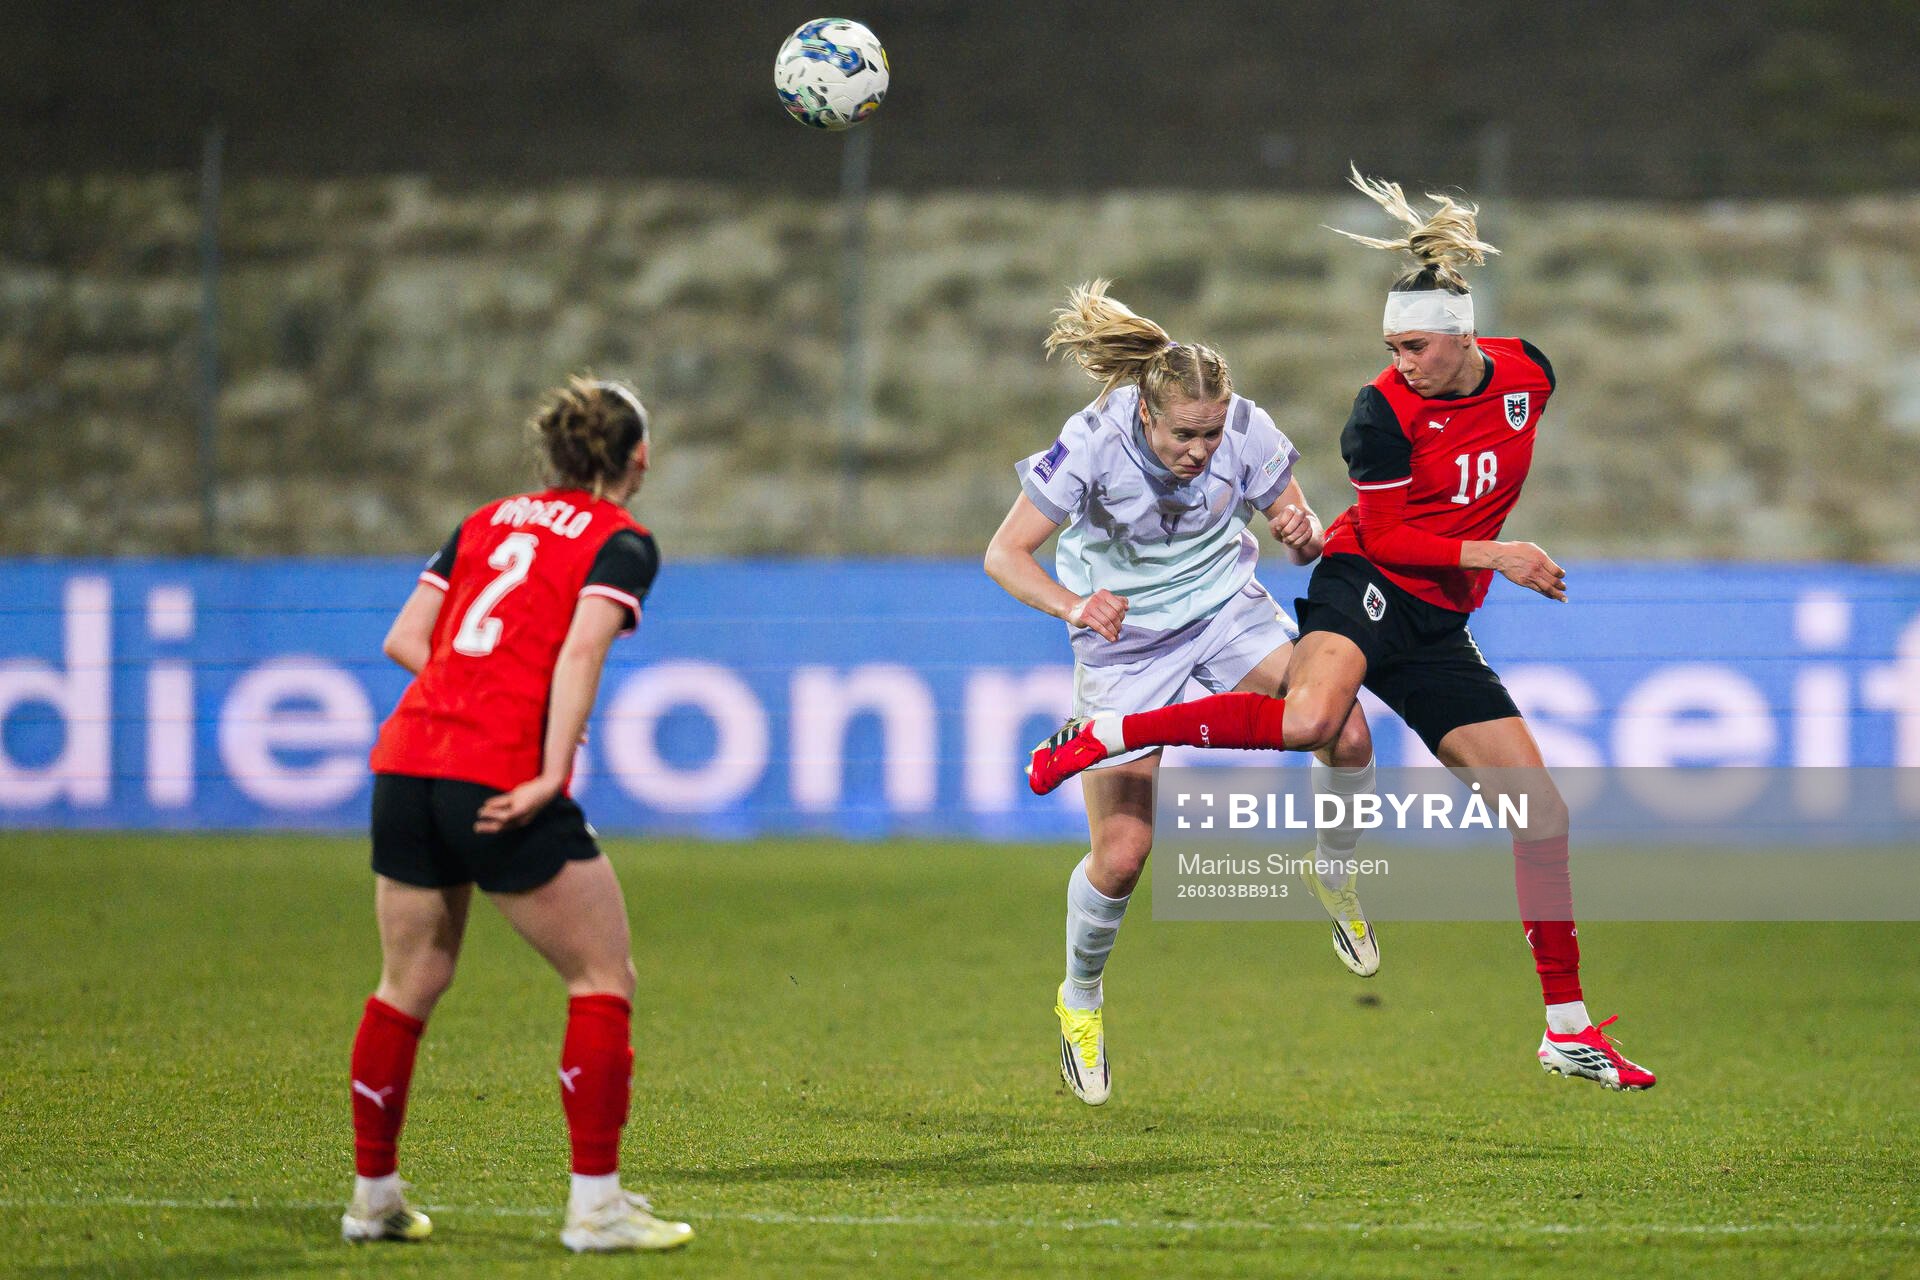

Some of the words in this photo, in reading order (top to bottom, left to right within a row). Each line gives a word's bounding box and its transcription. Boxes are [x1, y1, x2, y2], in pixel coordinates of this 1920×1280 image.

[1451, 451, 1498, 504] 18
[453, 532, 539, 657] 2
[0, 576, 374, 810] die
[1200, 724, 1210, 747] ÖF
